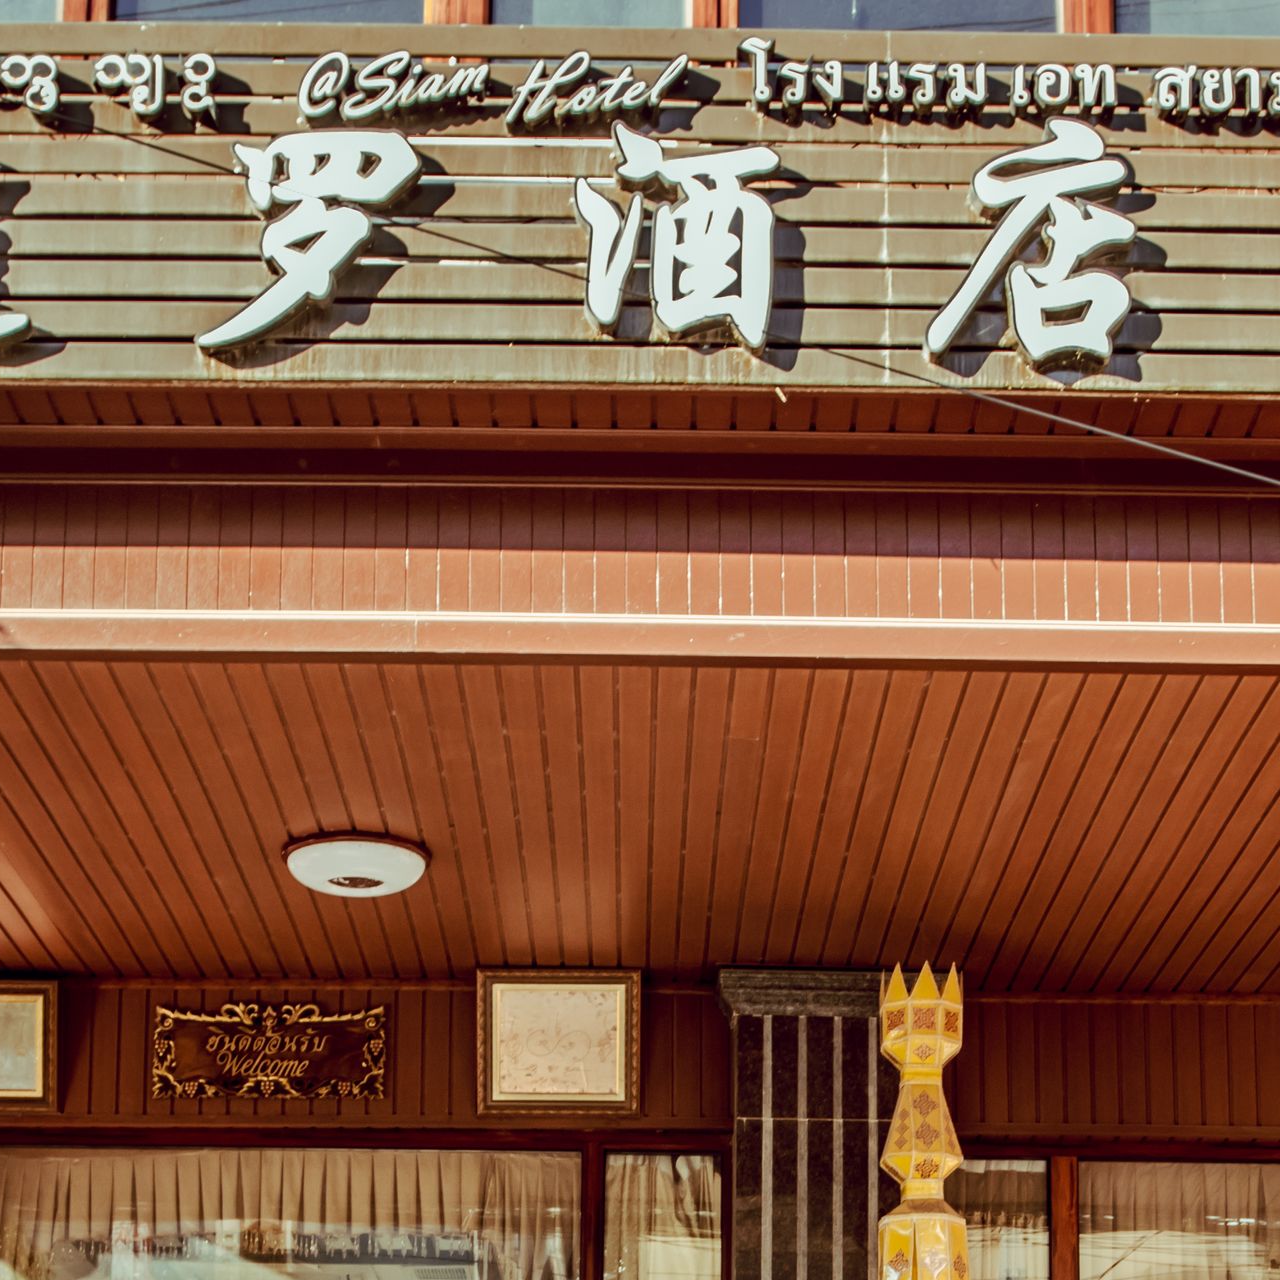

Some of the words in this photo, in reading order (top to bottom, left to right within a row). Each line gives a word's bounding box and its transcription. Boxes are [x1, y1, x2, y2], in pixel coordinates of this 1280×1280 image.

[298, 50, 489, 120] @Siam
[506, 50, 688, 124] Hotel
[217, 1051, 310, 1078] Welcome
